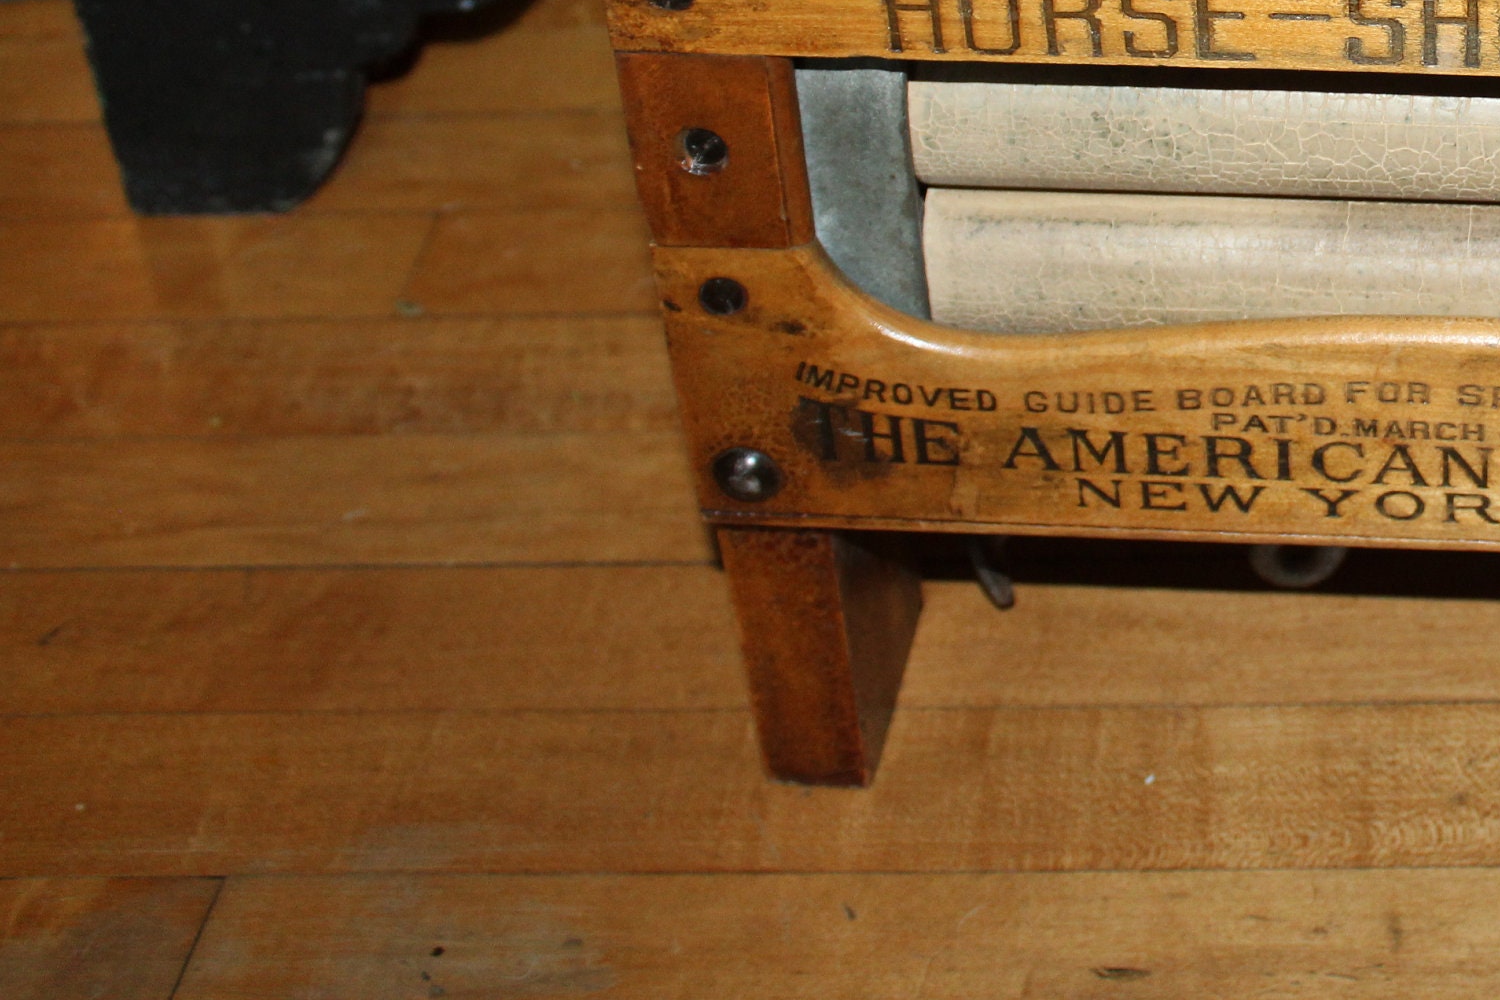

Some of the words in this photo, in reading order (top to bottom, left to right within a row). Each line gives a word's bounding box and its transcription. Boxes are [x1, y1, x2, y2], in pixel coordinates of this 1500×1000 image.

[795, 361, 998, 413] IMPROVED
[1023, 389, 1154, 415] GUIDE
[1176, 381, 1327, 410] BOARD
[1343, 380, 1431, 406] FOR
[800, 396, 961, 467] THE
[1001, 426, 1494, 490] AMERICAN
[1076, 478, 1267, 513] NEW
